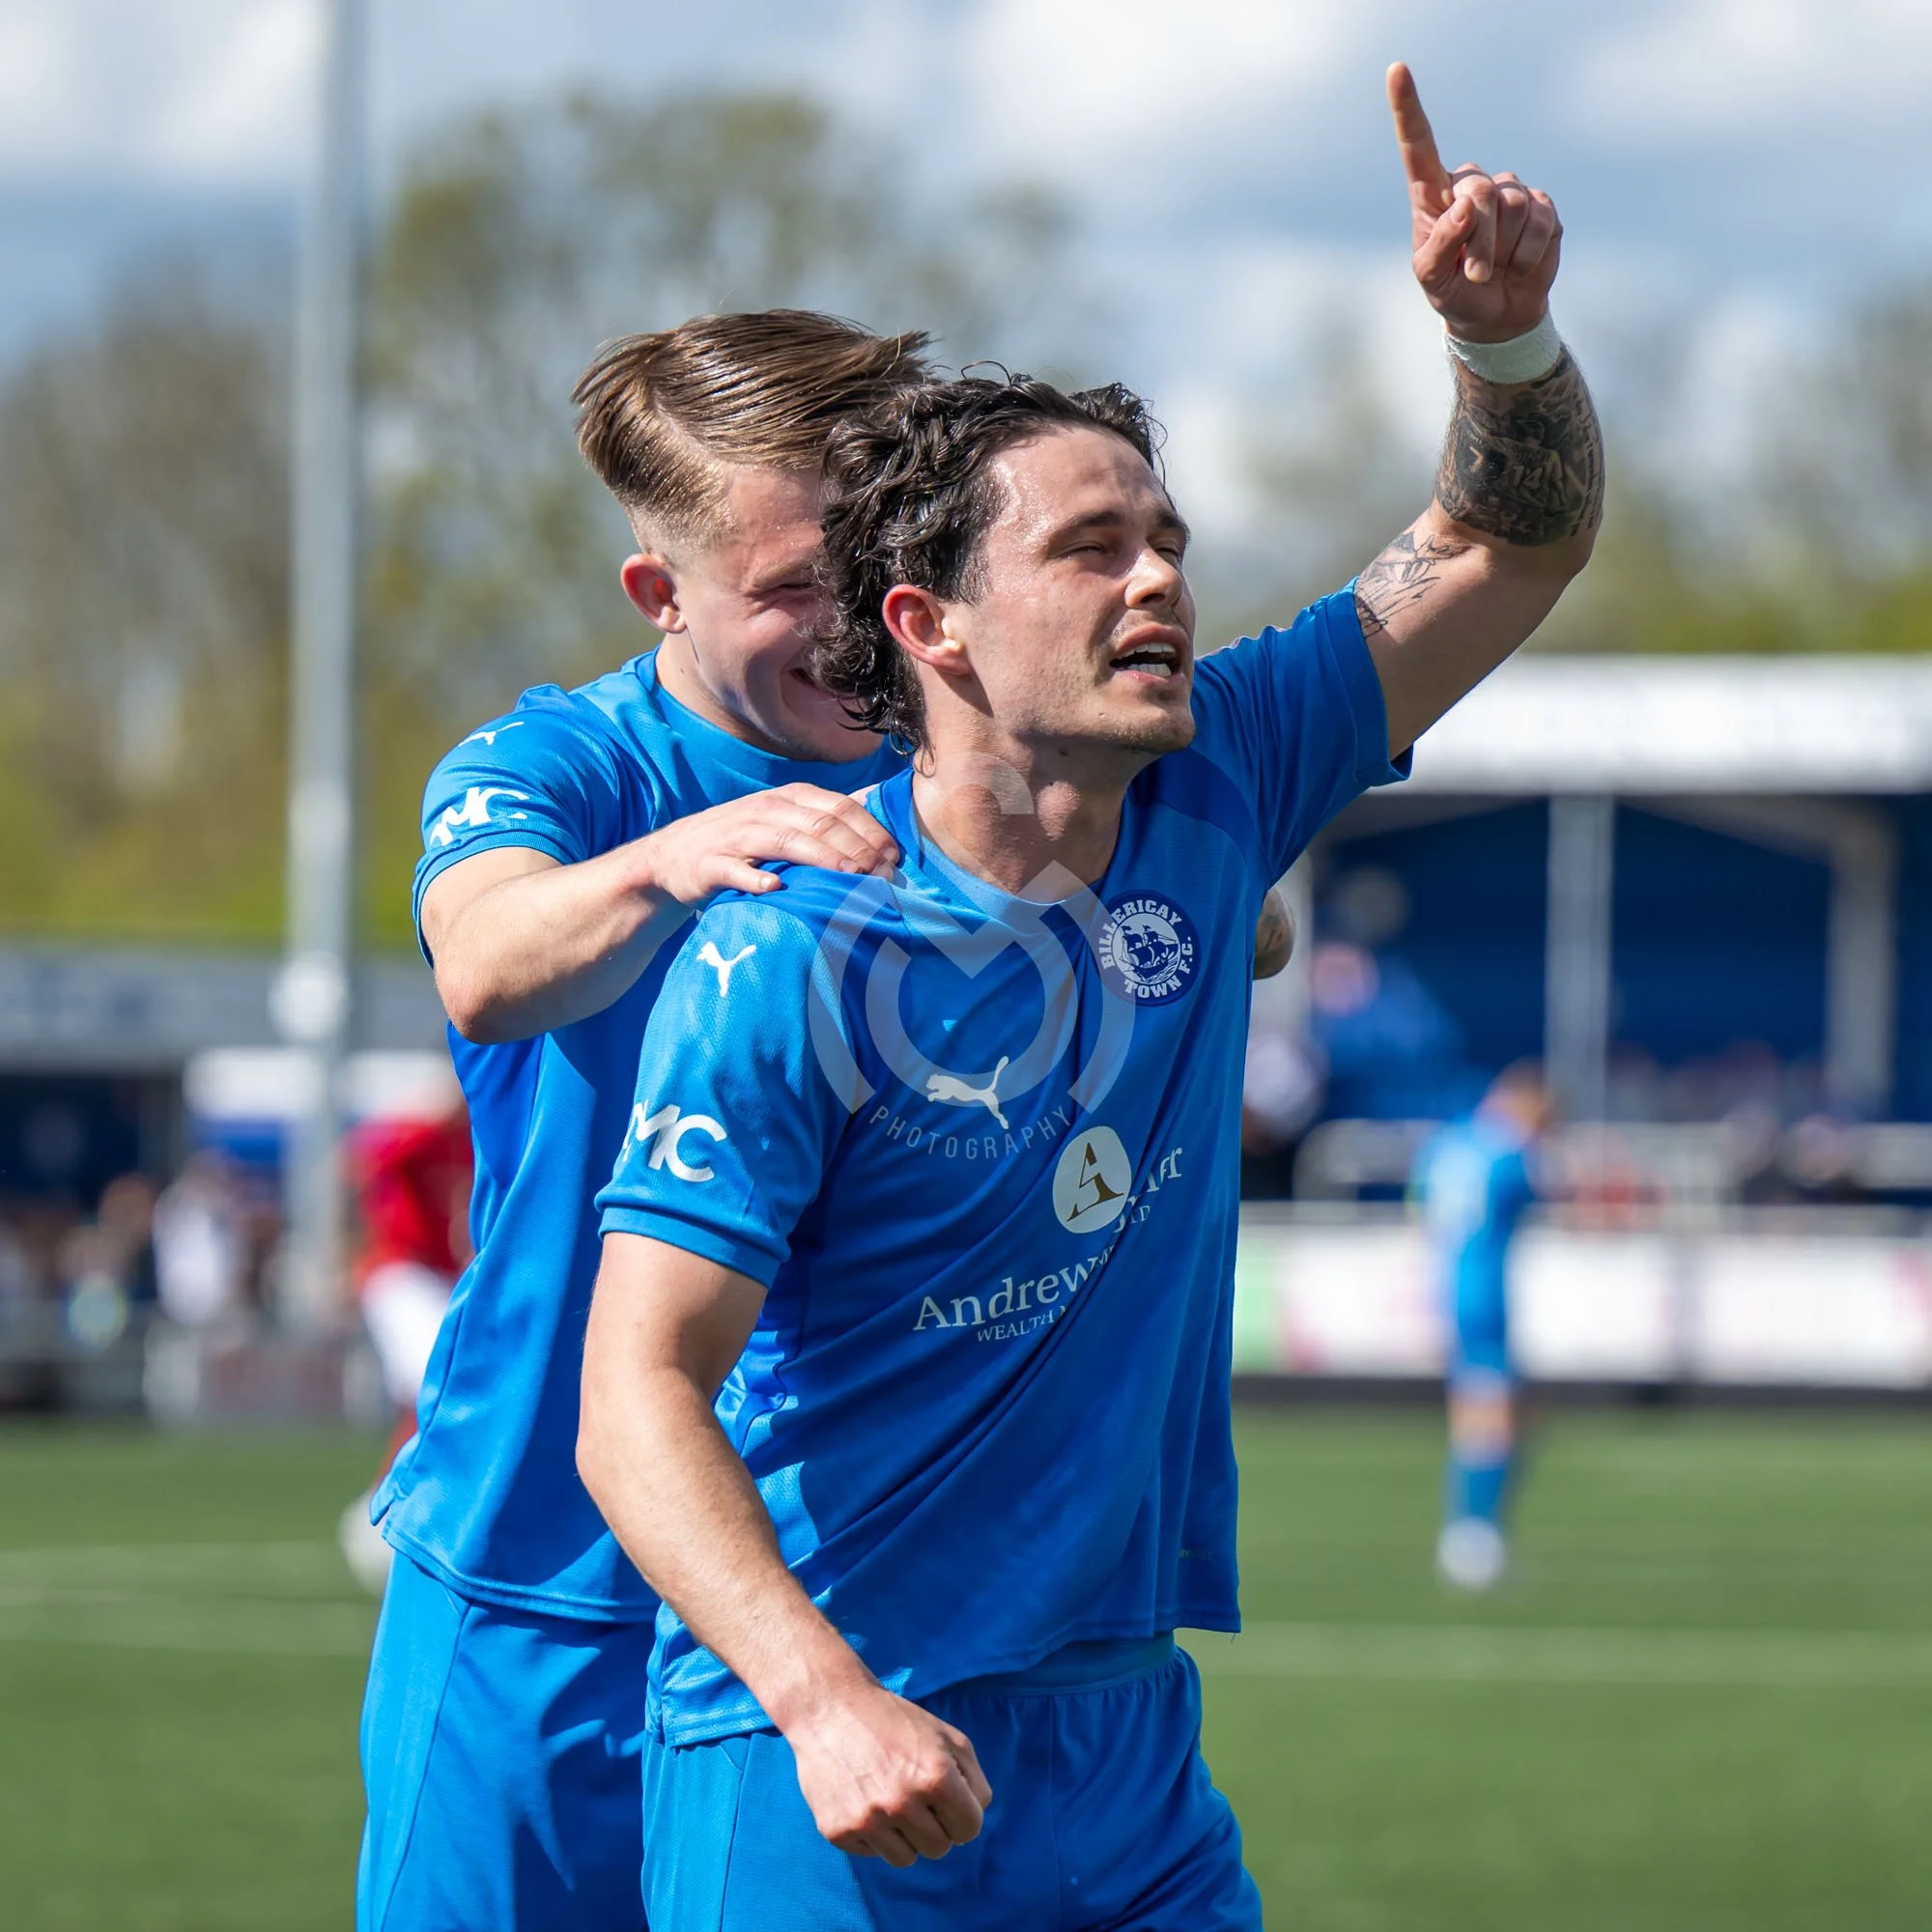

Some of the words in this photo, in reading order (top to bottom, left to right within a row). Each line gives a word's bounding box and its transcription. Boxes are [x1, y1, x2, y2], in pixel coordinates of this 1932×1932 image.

[1098, 899, 1182, 970] BILLERICAY
[1123, 975, 1182, 998] TOWN
[1179, 936, 1194, 975] F.C.
[977, 1309, 1055, 1342] WEALTH
